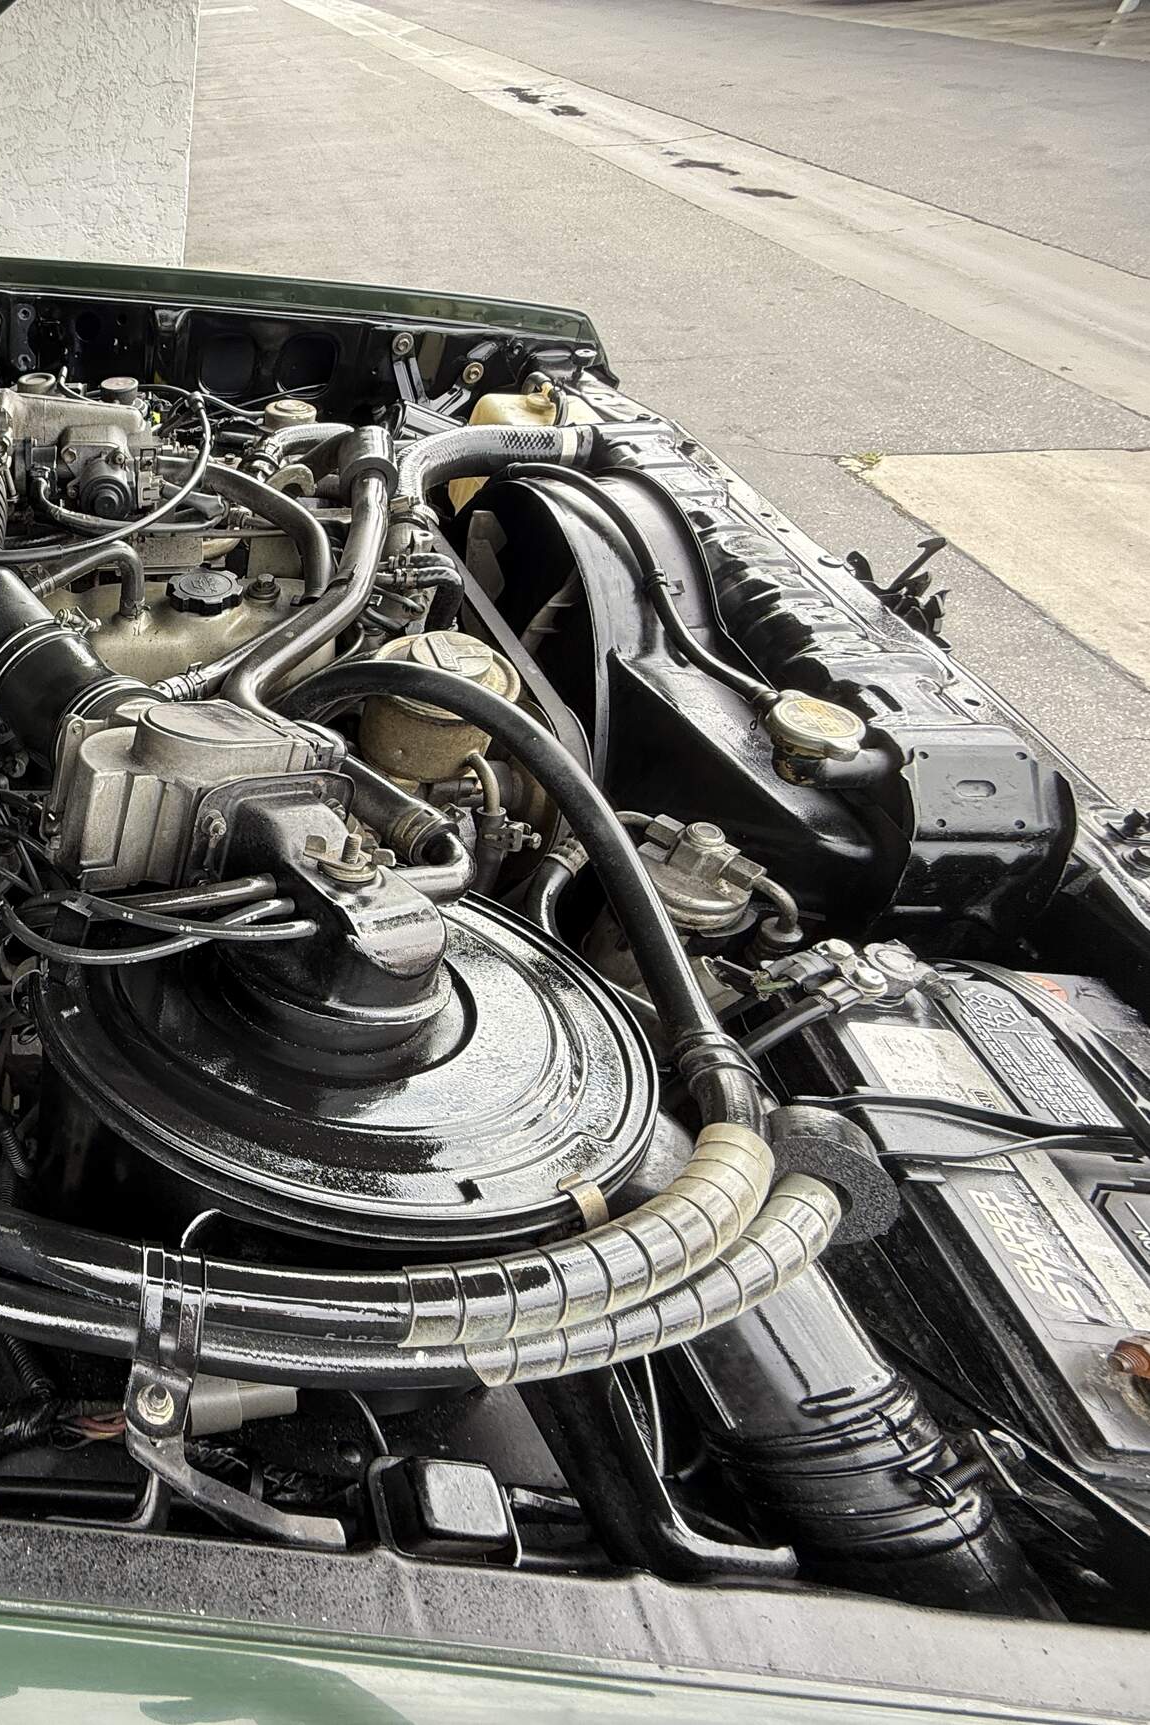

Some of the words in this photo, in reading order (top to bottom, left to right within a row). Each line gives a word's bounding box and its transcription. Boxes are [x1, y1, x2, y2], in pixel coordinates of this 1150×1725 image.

[973, 1090, 996, 1110] STD
[968, 1189, 1046, 1294] SUPER
[989, 1191, 1096, 1317] START
